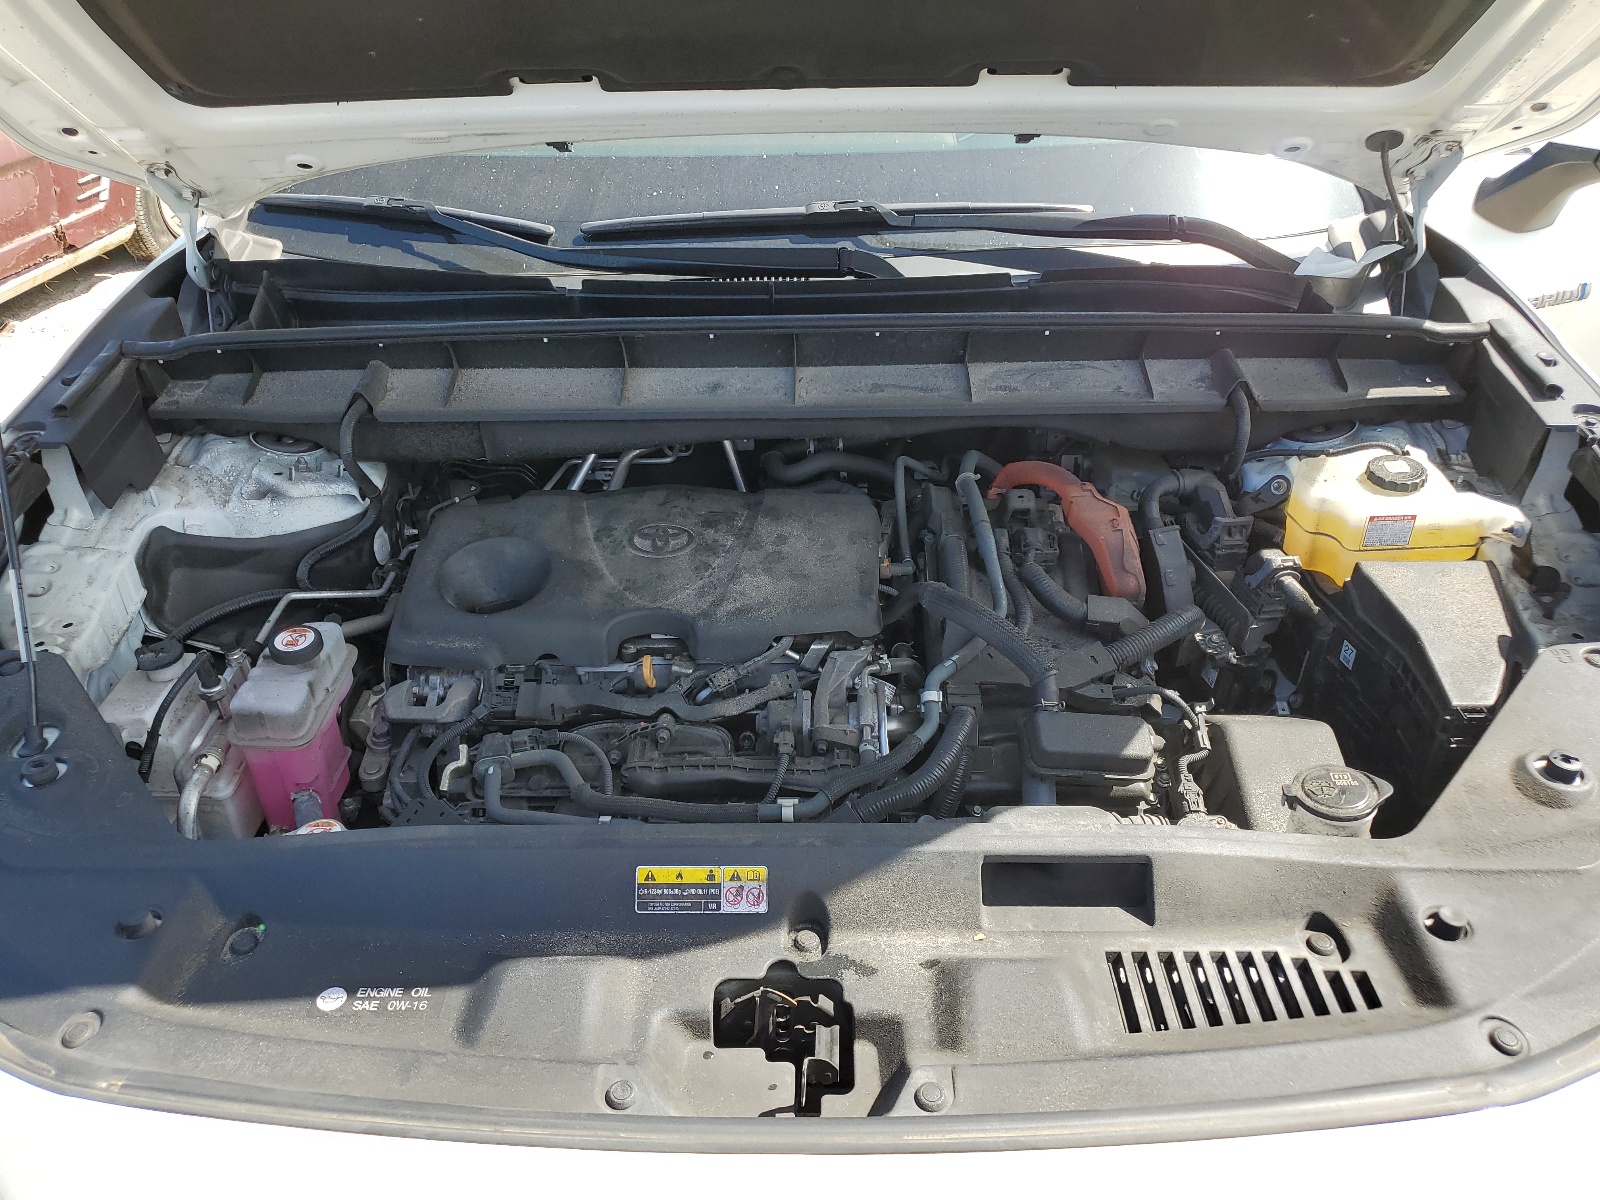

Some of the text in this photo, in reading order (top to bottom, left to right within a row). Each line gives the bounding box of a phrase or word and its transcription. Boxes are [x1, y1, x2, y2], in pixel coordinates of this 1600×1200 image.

[1343, 644, 1354, 657] 27
[356, 987, 432, 998] ENGINE OIL
[352, 1000, 428, 1011] SAE 0W-16
